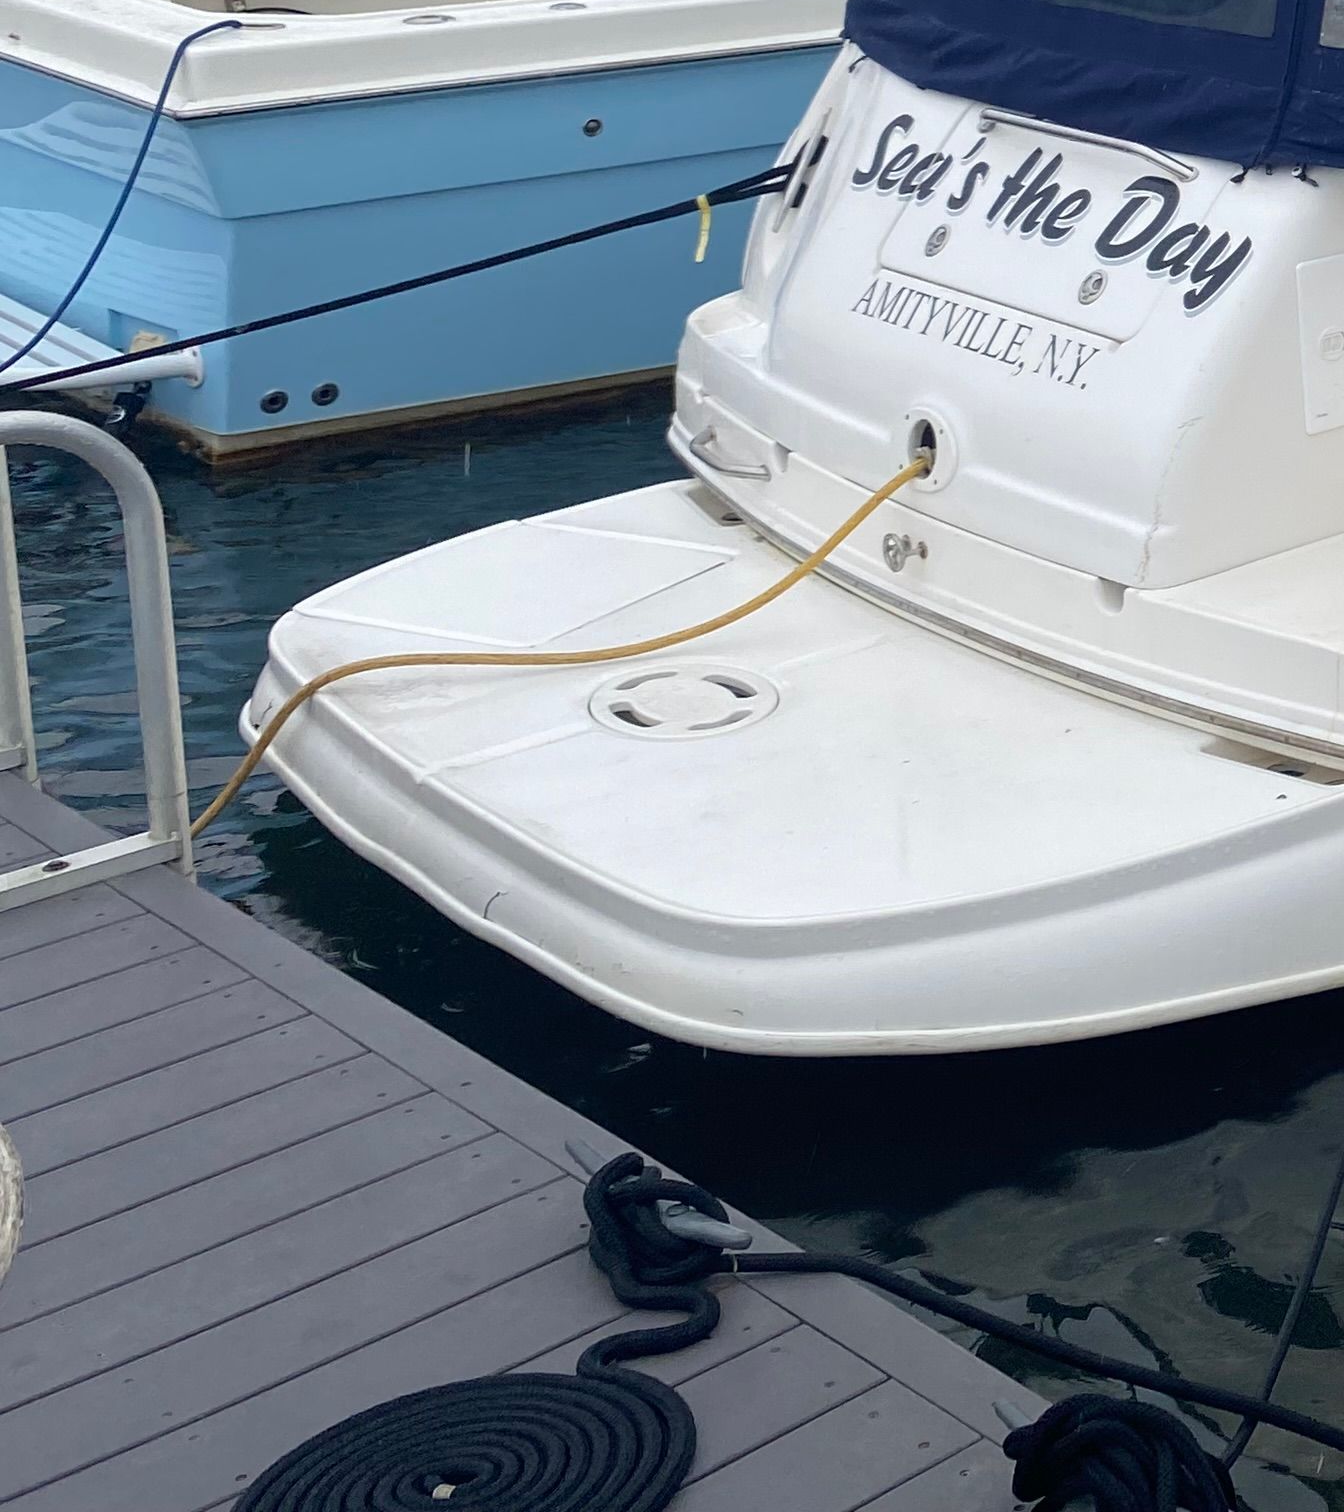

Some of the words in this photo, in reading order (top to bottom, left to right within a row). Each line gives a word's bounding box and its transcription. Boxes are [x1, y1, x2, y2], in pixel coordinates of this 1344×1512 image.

[851, 113, 990, 212] Sea's
[986, 146, 1093, 241] the
[1094, 175, 1253, 313] Day
[851, 279, 1034, 377] AMITYVILLE,
[1033, 333, 1101, 391] N.Y.
